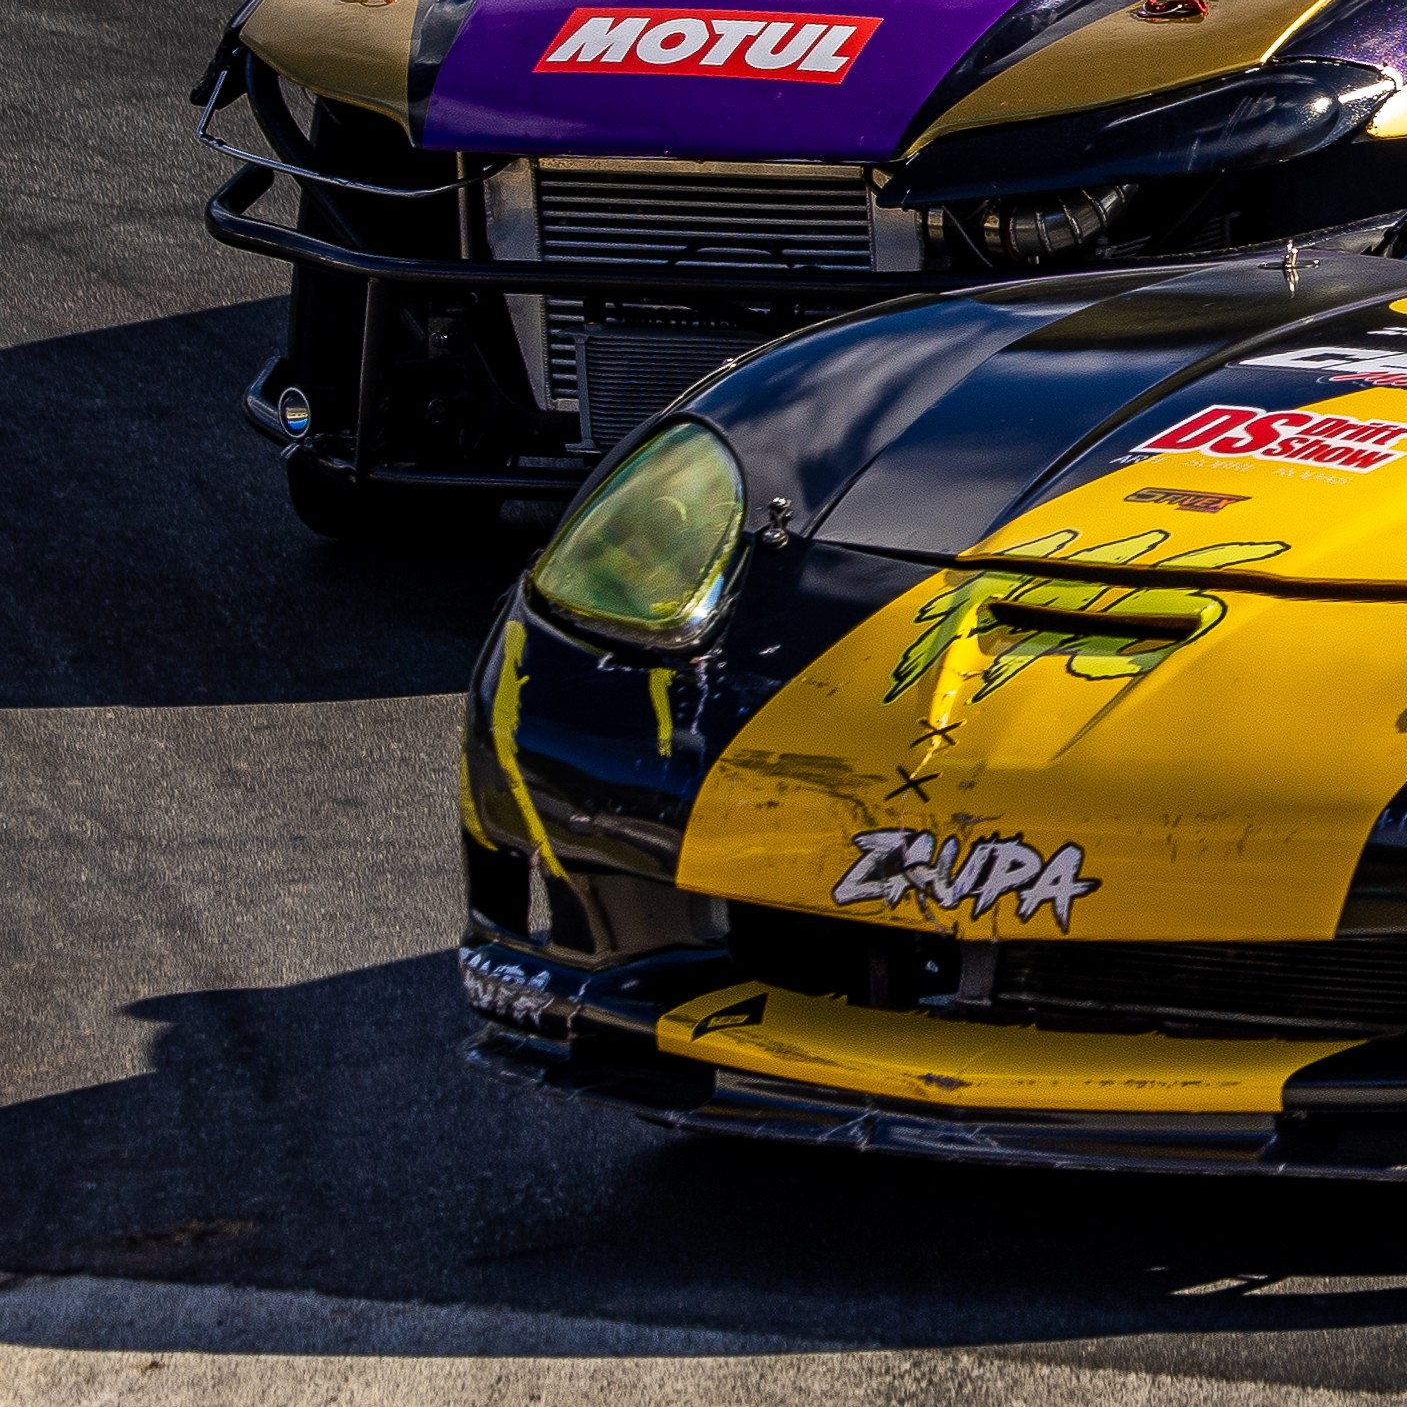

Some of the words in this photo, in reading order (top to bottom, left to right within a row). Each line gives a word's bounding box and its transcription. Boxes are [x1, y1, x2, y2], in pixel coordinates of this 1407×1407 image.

[545, 17, 860, 73] MOTUL
[1141, 408, 1315, 455] DS
[834, 828, 1099, 933] ZAUPA
